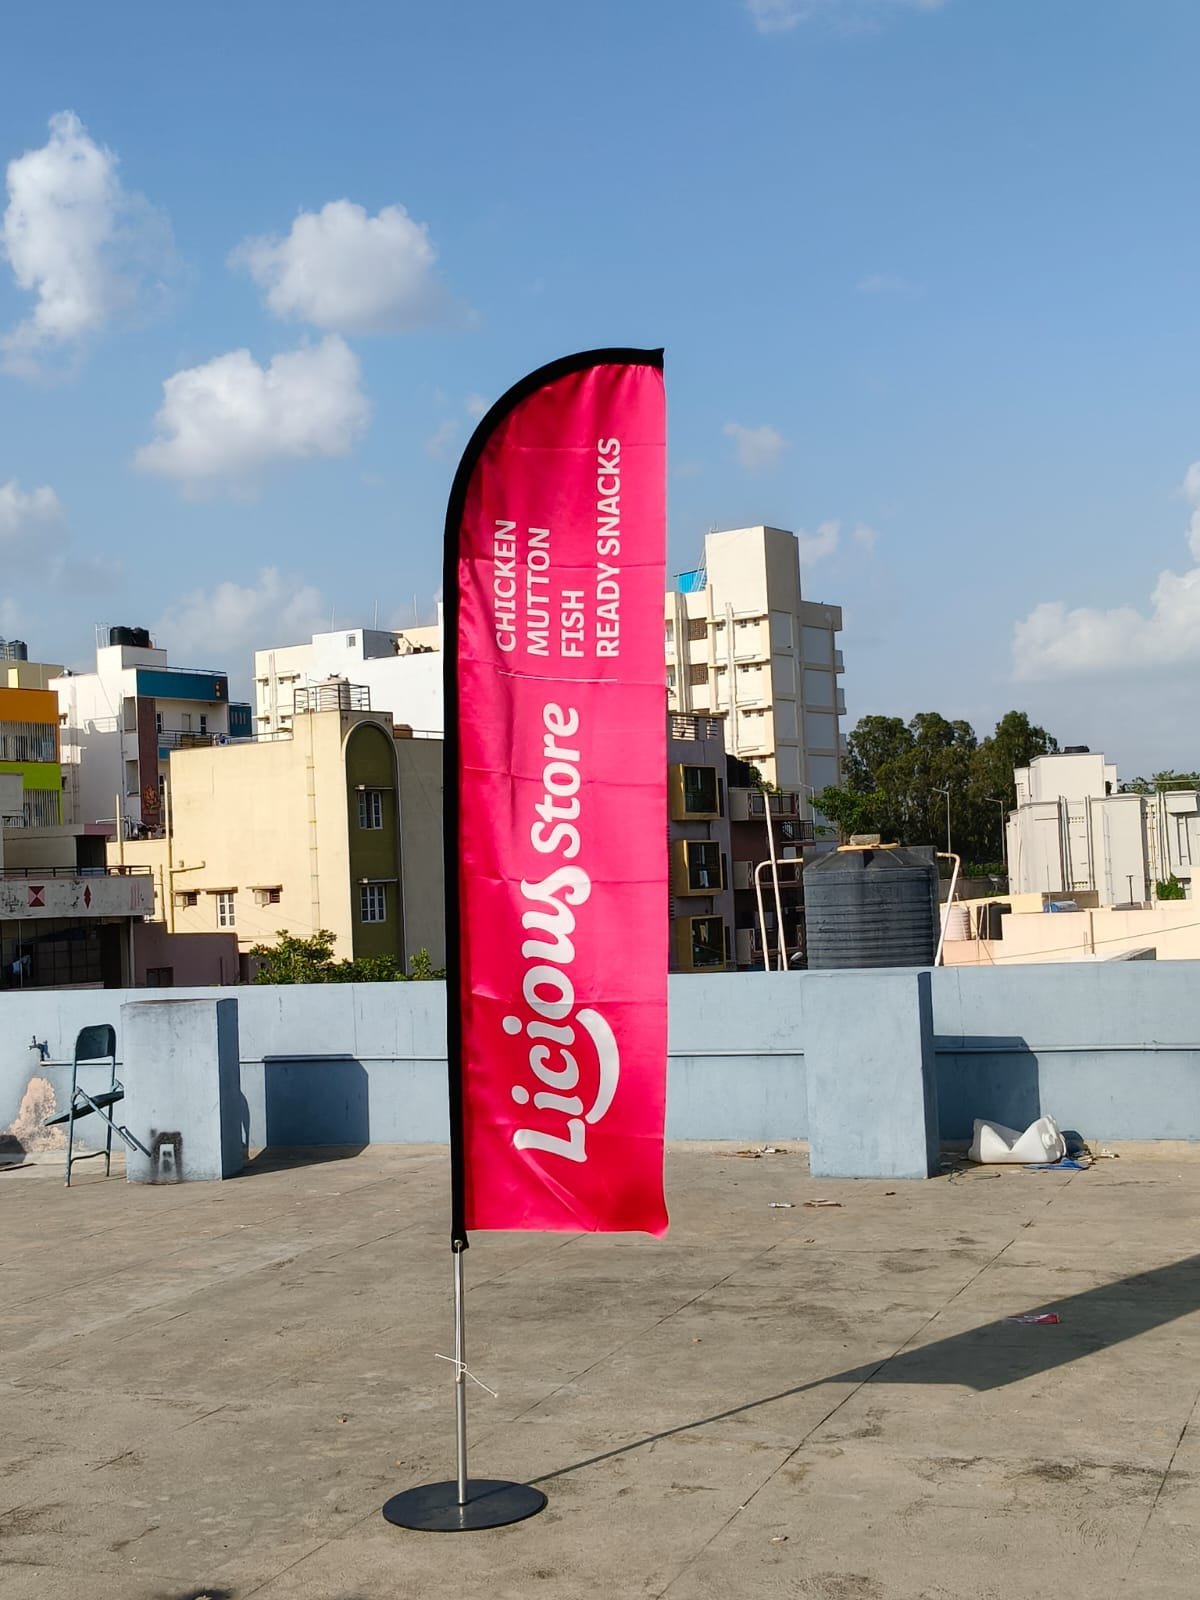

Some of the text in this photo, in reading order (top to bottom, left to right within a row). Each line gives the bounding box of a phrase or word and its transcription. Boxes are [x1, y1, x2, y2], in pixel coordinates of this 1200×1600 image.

[493, 520, 517, 653] CHICKEN
[526, 527, 550, 657] MUTTON
[595, 437, 621, 658] READY SNACKS
[560, 590, 585, 657] FISH
[502, 702, 593, 1163] Licious Store
